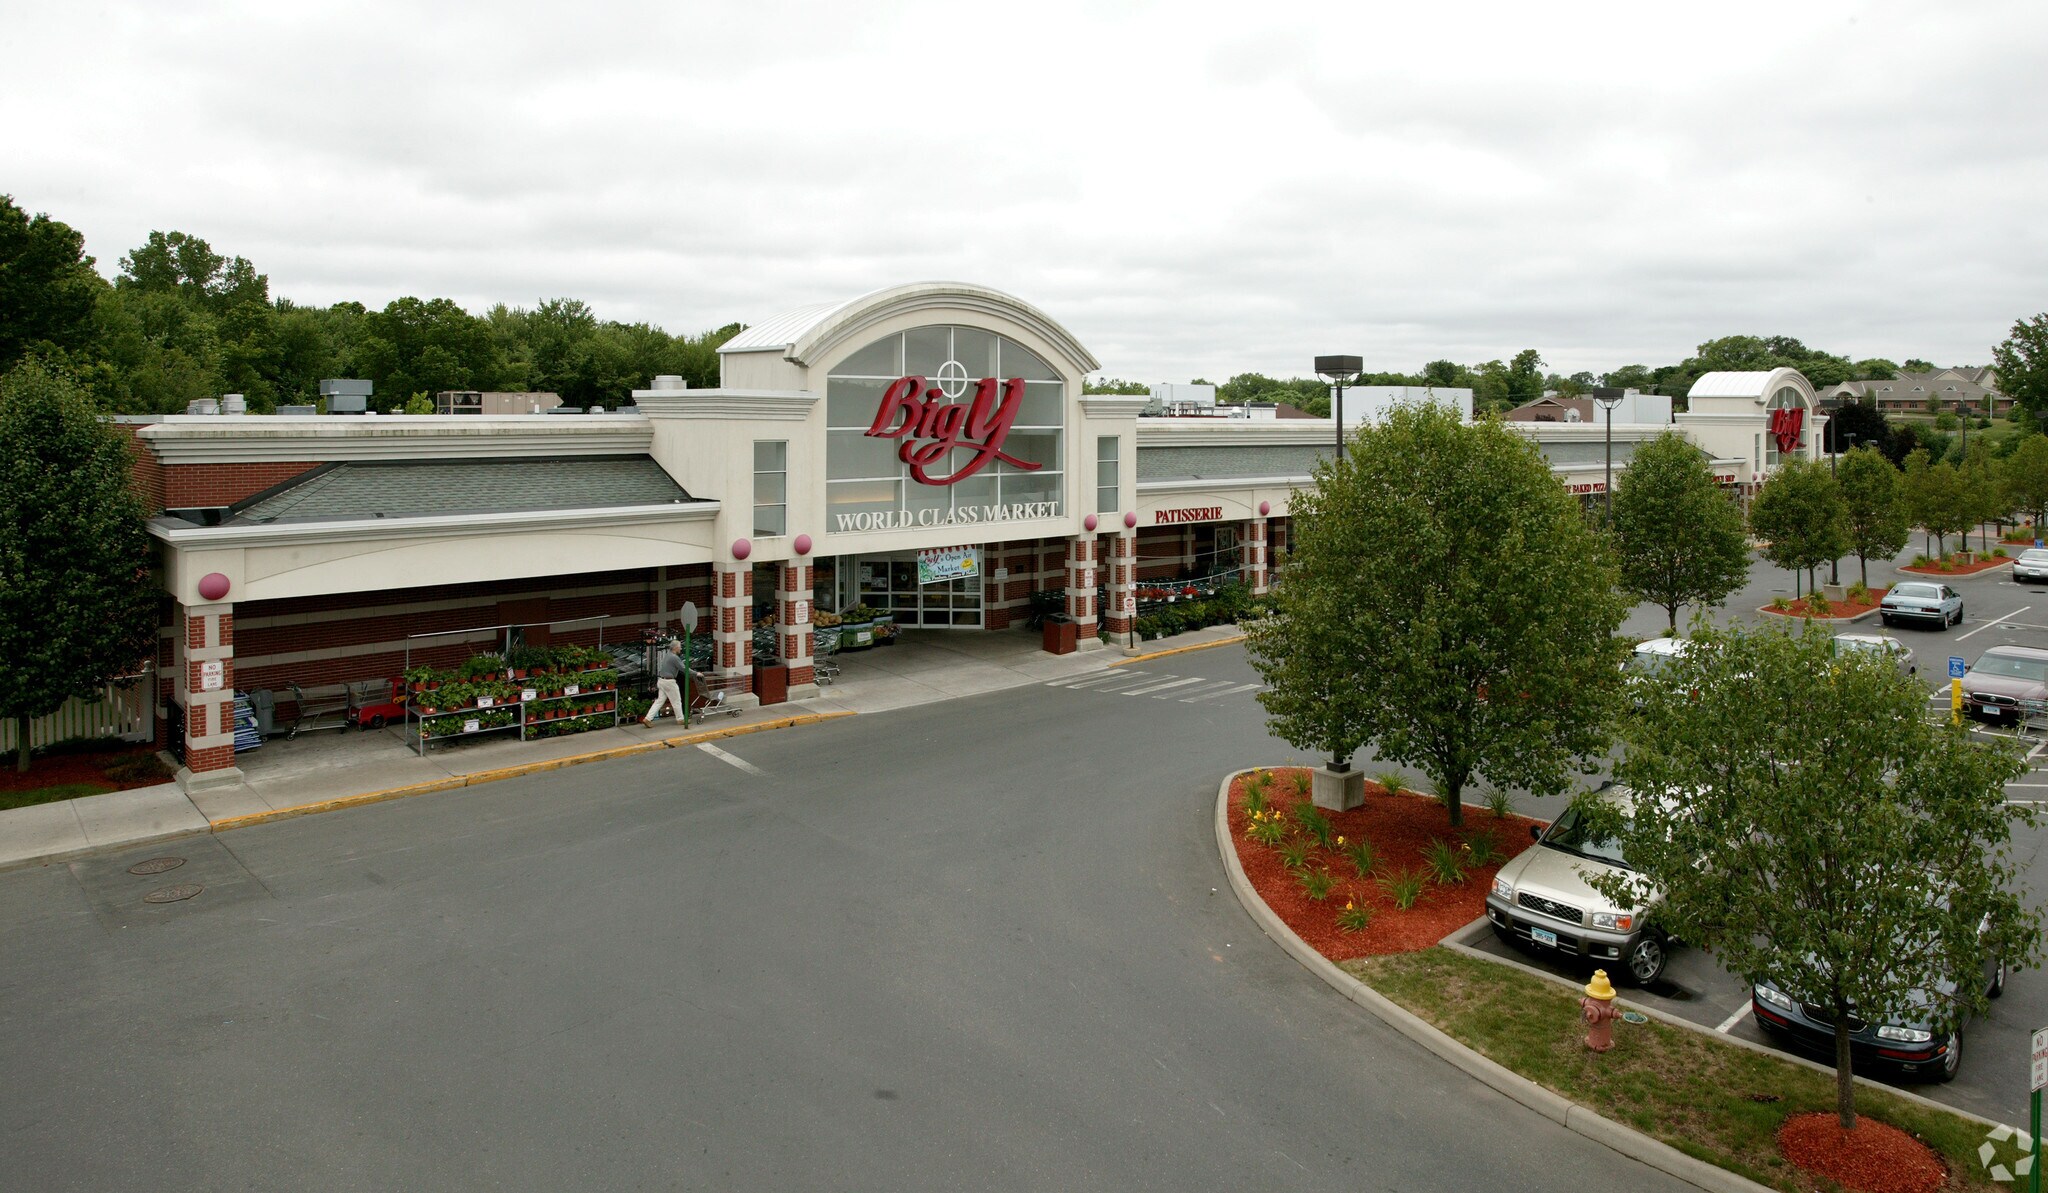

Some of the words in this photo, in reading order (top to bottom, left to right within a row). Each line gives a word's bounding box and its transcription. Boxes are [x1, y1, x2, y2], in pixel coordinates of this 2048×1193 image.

[1572, 483, 1592, 494] BAKED
[836, 510, 913, 532] WORLD
[918, 505, 978, 527] CLASS
[982, 501, 1059, 522] MARKET
[1155, 506, 1223, 524] PATISSERIE
[945, 553, 961, 562] Open
[963, 551, 972, 559] Air
[937, 564, 960, 574] Market
[2037, 1034, 2043, 1046] NO
[2035, 1073, 2043, 1083] LANE
